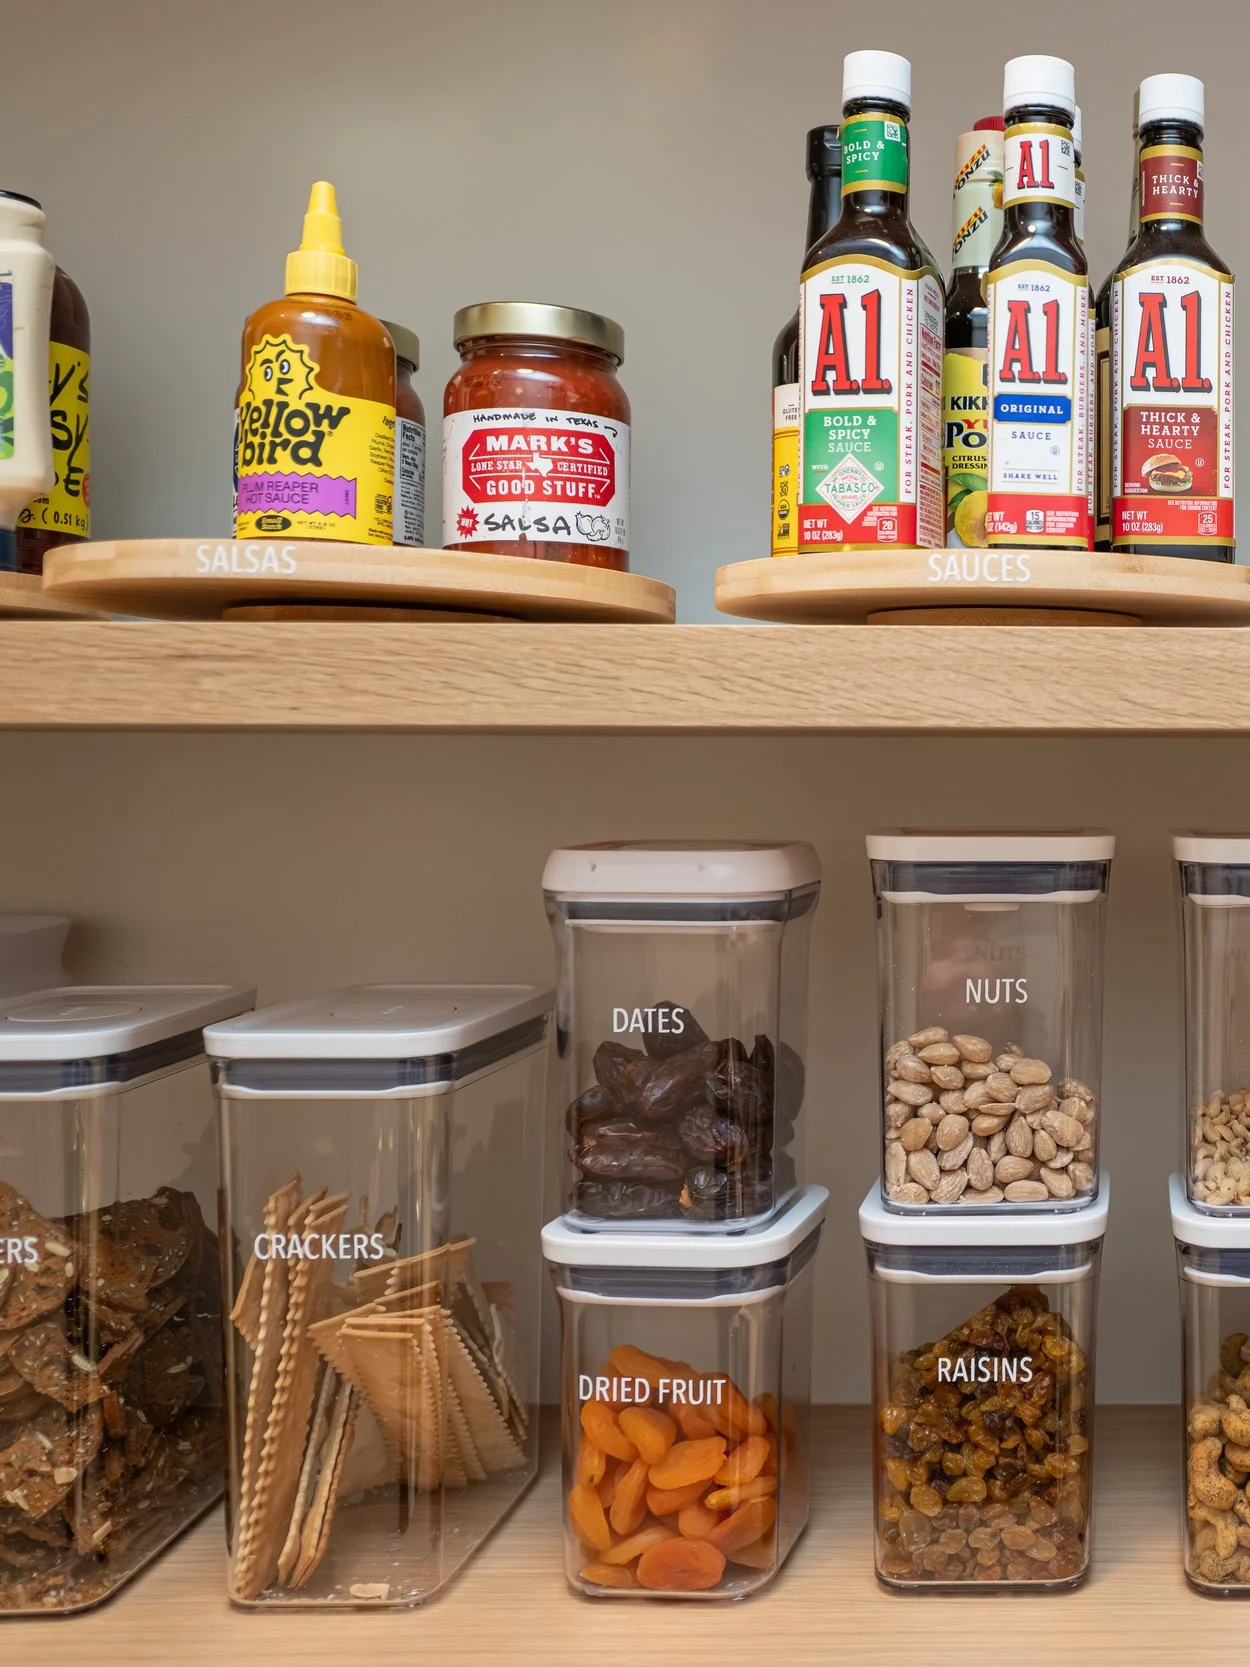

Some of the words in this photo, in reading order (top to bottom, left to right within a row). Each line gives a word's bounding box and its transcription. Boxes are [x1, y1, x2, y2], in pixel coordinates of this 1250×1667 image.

[843, 140, 871, 154] BOLD
[876, 140, 886, 150] &
[846, 151, 881, 165] SPICY
[1152, 175, 1190, 184] THICK
[1193, 179, 1199, 188] &
[1152, 185, 1199, 198] HEARTY
[847, 275, 870, 284] 1862
[1166, 276, 1190, 285] 1862
[1031, 284, 1050, 292] 1862
[906, 288, 914, 344] CHICKEN
[906, 351, 914, 376] AND
[905, 383, 914, 414] PORK
[1001, 404, 1063, 415] ORIGINAL
[473, 412, 537, 424] HANDMADE
[566, 417, 599, 429] TEXAS
[824, 416, 862, 427] BOLD
[867, 415, 877, 426] &
[1140, 412, 1185, 423] THICK
[1191, 412, 1201, 423] &
[829, 429, 871, 440] SPICY
[1012, 431, 1052, 440] SAUCE
[1141, 424, 1200, 436] HEARTY
[486, 435, 593, 454] MARK'S
[828, 442, 872, 452] SAUCE
[1148, 438, 1192, 449] SAUCE
[471, 461, 493, 472] LONE
[496, 461, 523, 470] STAR
[557, 461, 608, 476] CERTIFIED
[904, 471, 912, 494] FOR
[1003, 472, 1031, 480] SHAKE
[242, 481, 264, 492] PLUM
[267, 481, 319, 494] REAPER
[486, 480, 535, 495] GOOD
[542, 482, 596, 499] STUFF
[246, 493, 262, 503] HOT
[265, 493, 310, 504] SAUCE
[993, 511, 1005, 521] WT
[1031, 512, 1040, 520] 15
[1122, 511, 1135, 520] NET
[1136, 511, 1148, 520] WT
[1202, 515, 1213, 524] 25
[484, 512, 572, 536] SALSA
[803, 520, 816, 529] NET
[817, 519, 828, 529] WT
[1122, 522, 1130, 531] 10
[1131, 522, 1141, 531] OZ
[1142, 522, 1164, 533] (283g)
[803, 532, 811, 541] 10
[812, 531, 821, 541] OZ
[196, 544, 298, 575] SALSAS
[928, 553, 1031, 582] SAUCES
[965, 978, 1029, 1004] NUTS
[612, 1008, 686, 1035] DATES
[254, 1232, 385, 1260] CRACKERS
[936, 1357, 1033, 1383] RAISINS
[578, 1375, 651, 1405] DRIED
[658, 1378, 728, 1406] FRUIT
